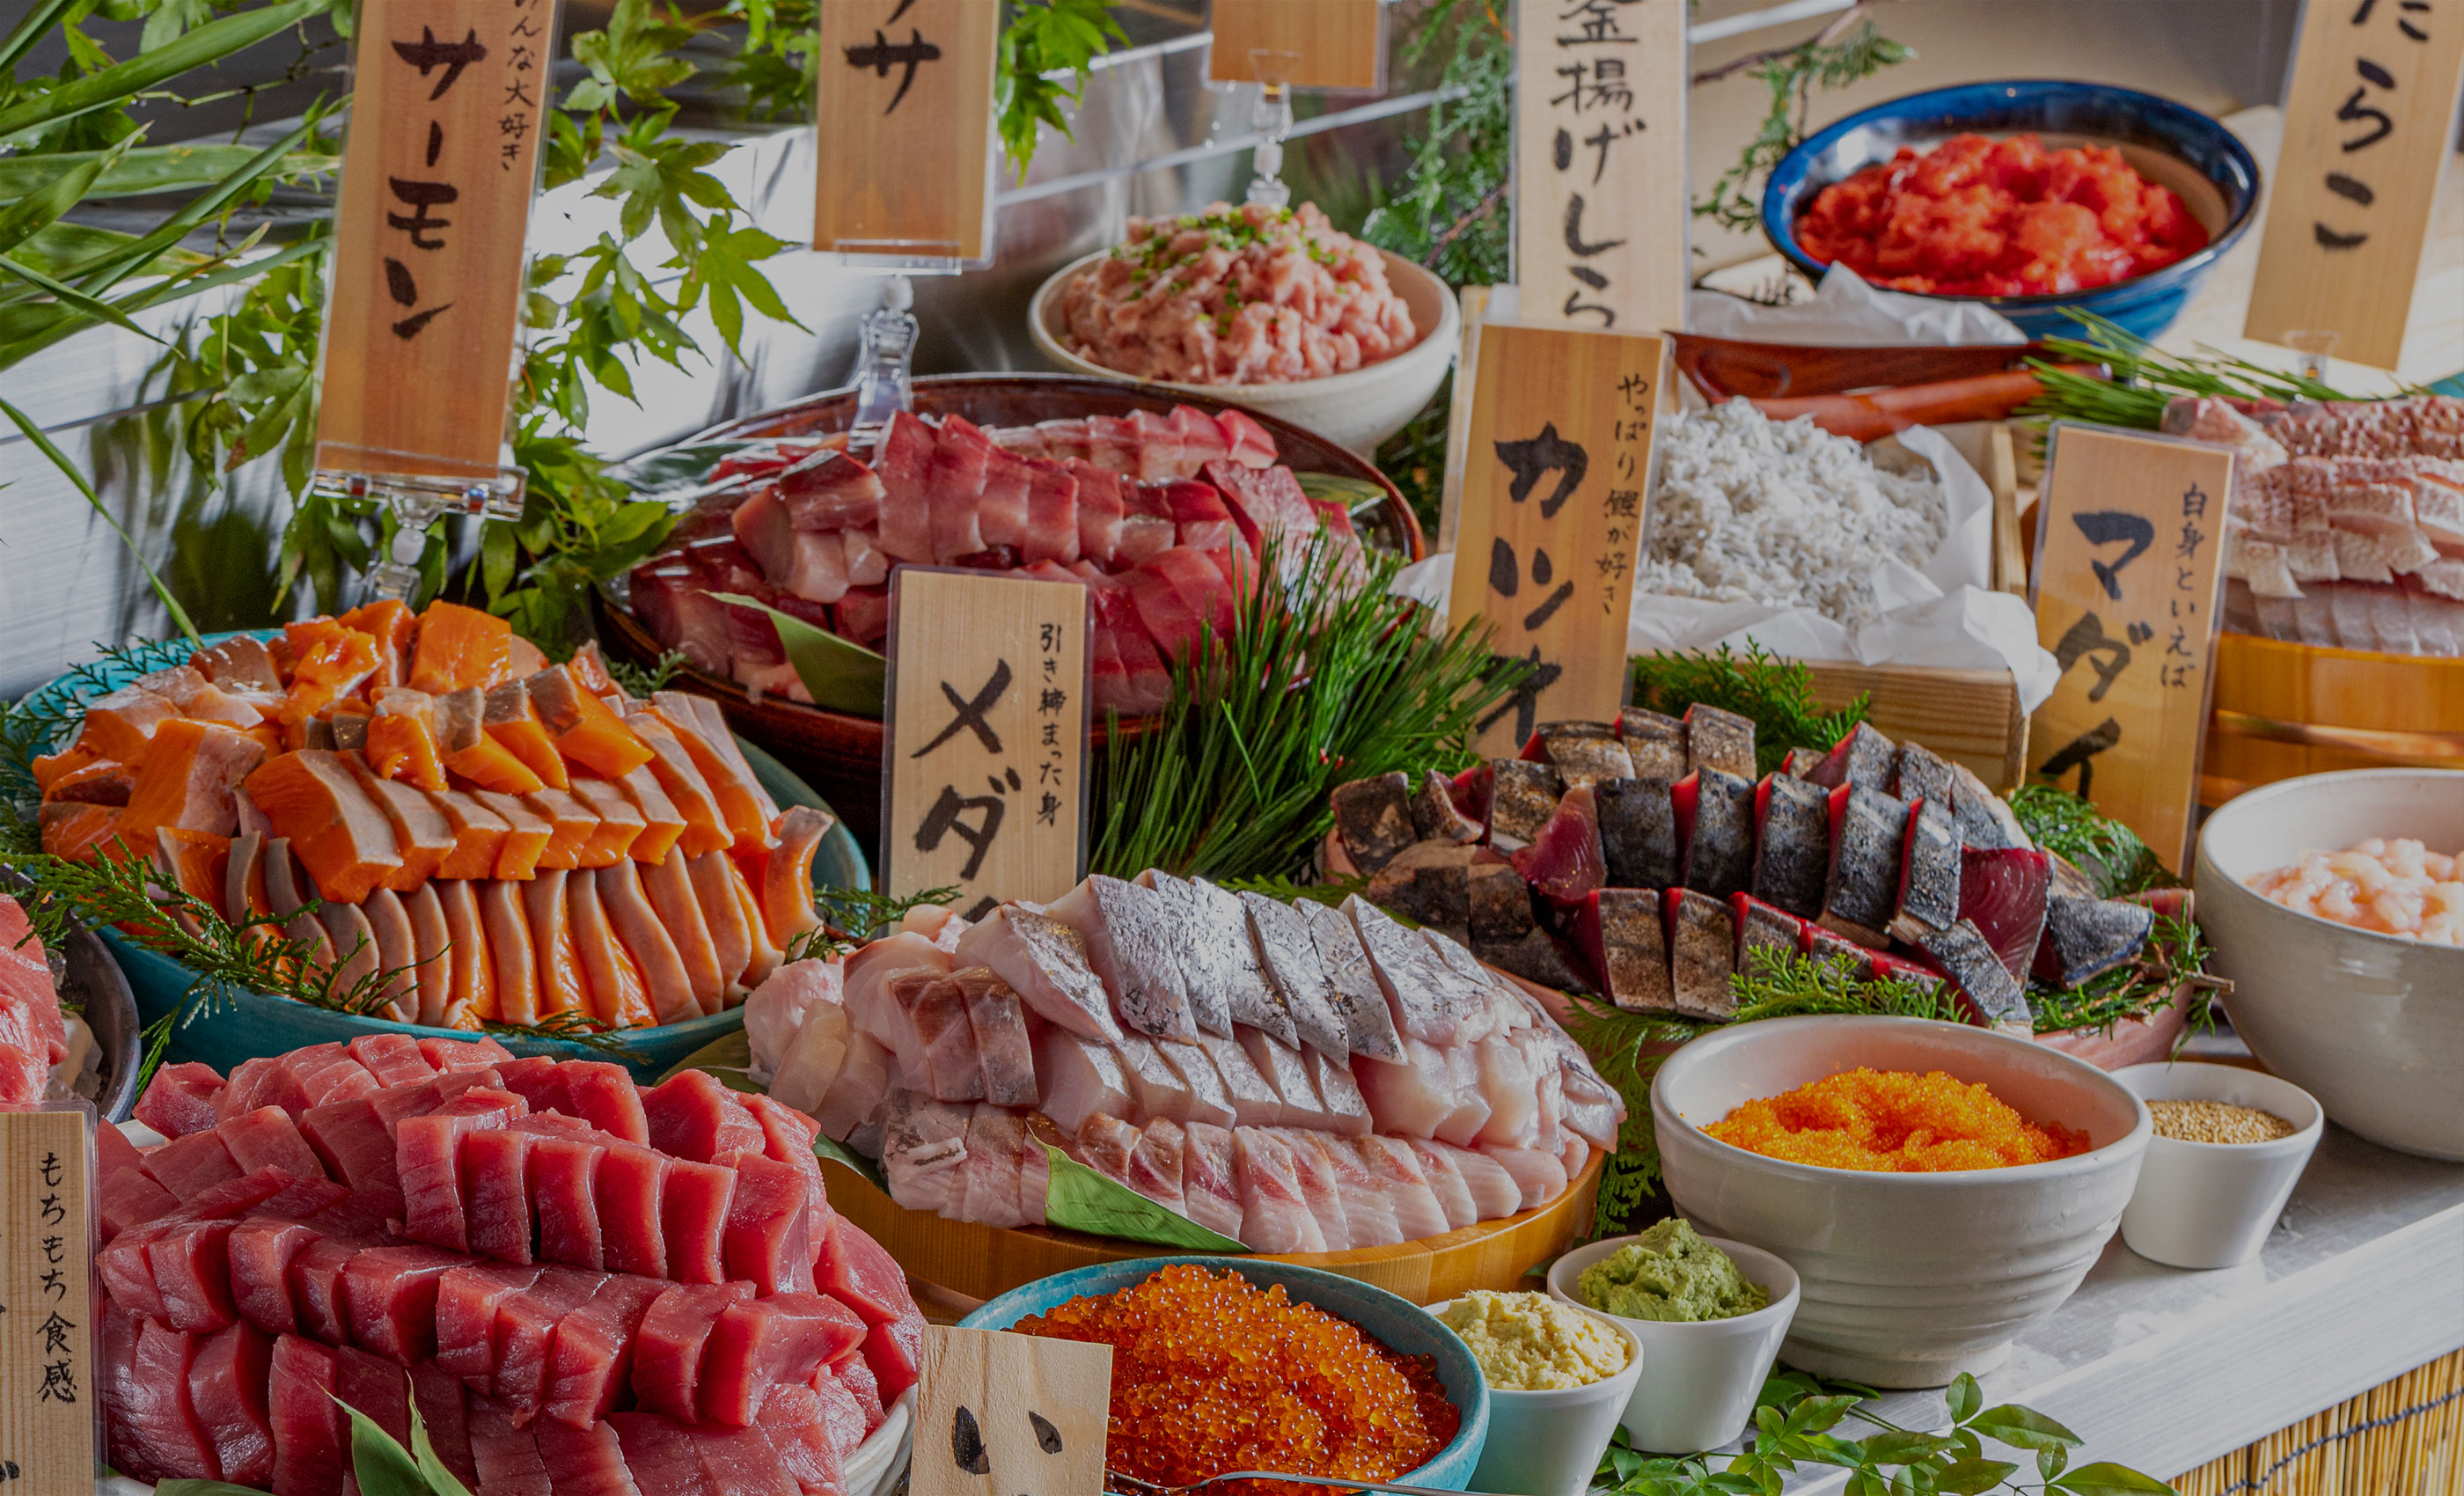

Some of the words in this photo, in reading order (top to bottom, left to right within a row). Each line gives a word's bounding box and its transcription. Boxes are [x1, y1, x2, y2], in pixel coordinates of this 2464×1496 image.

[500, 0, 541, 170] んな大好き
[843, 0, 942, 114] サ
[385, 25, 488, 341] サーモン
[1595, 373, 1648, 614] やっぱり鰹が好き
[2160, 482, 2208, 688] 白身といえば
[1037, 623, 1067, 826] 引き締まった身
[36, 1152, 77, 1403] もちもち食感
